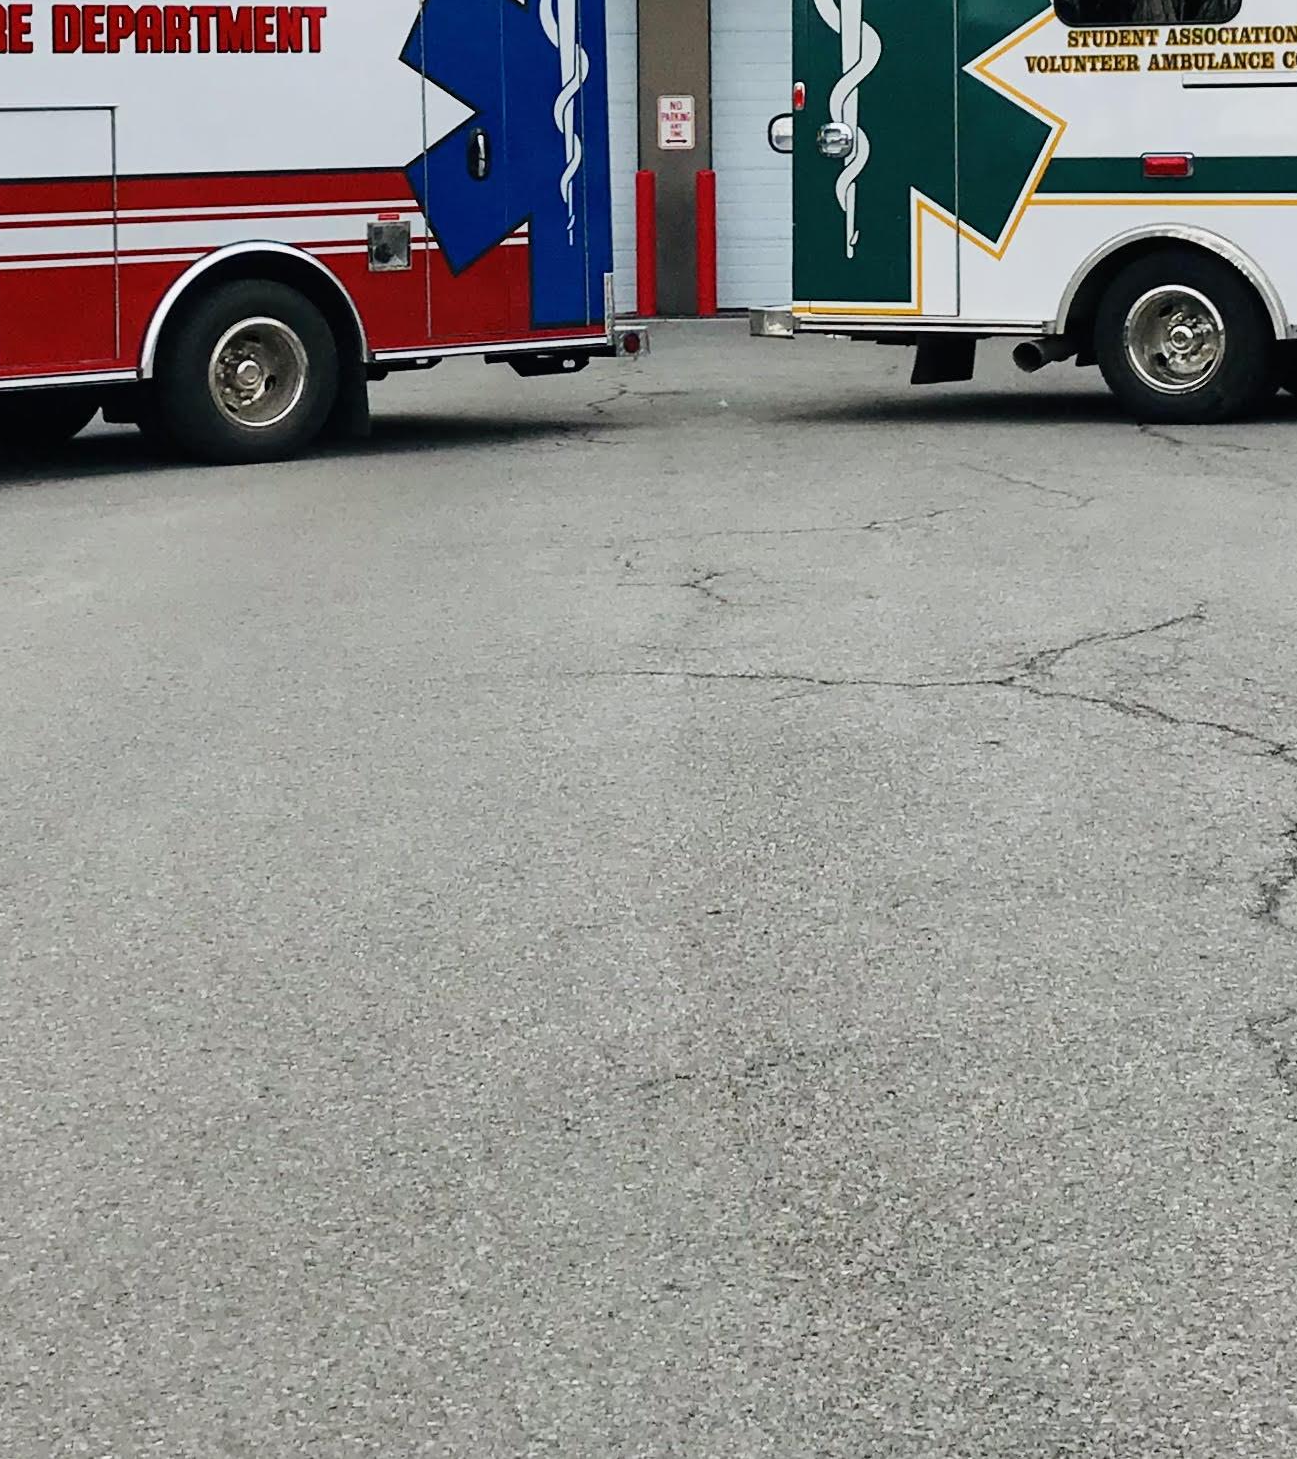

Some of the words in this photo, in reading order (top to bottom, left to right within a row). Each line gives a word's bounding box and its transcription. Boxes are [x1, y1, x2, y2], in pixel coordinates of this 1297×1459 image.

[52, 4, 327, 54] DEPARTMENT
[1067, 29, 1160, 48] STUDENT
[1025, 53, 1140, 73] VOLUNTEER
[1147, 51, 1275, 71] AMBULANCE
[670, 101, 683, 110] NO
